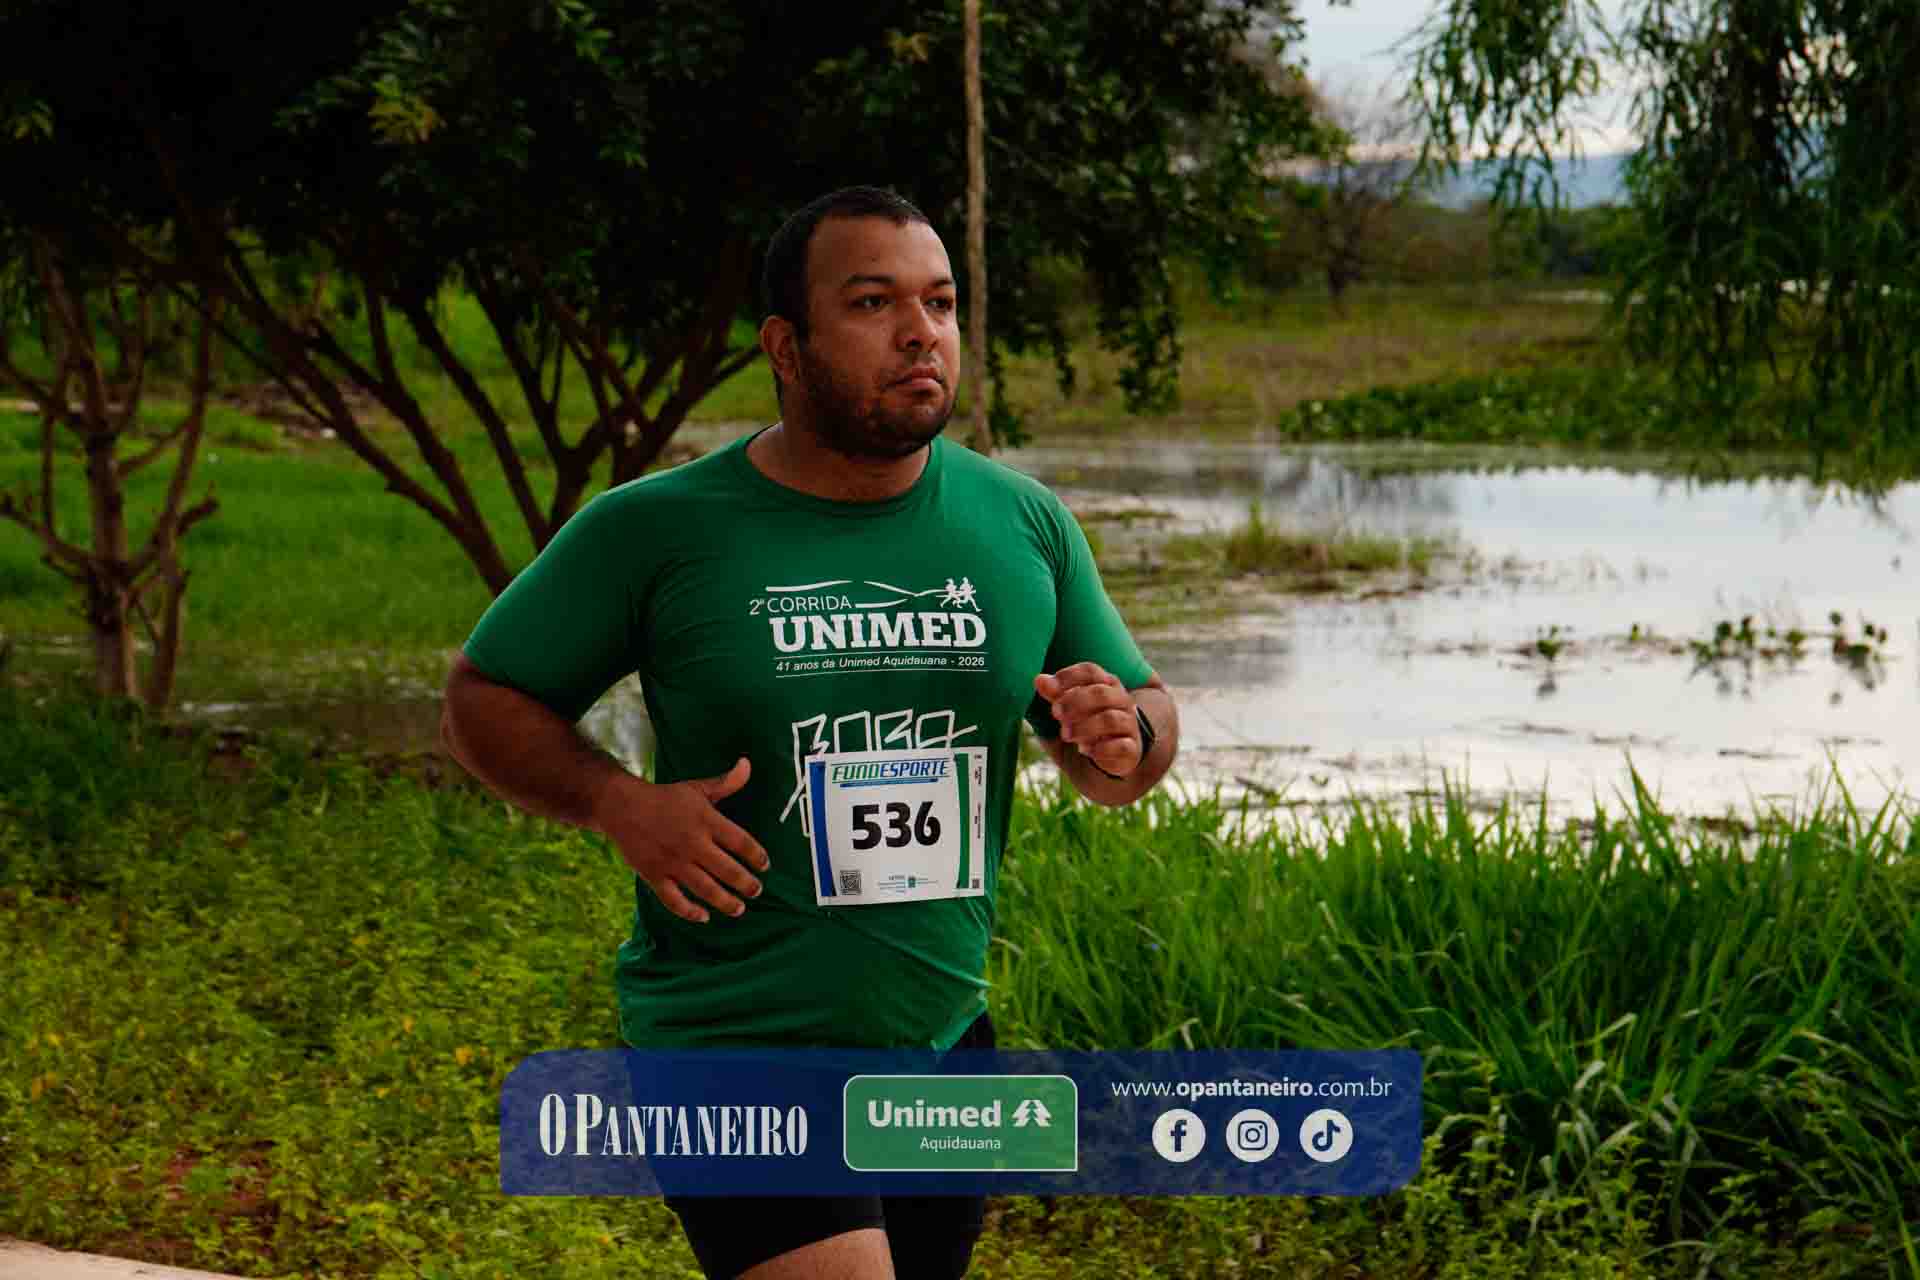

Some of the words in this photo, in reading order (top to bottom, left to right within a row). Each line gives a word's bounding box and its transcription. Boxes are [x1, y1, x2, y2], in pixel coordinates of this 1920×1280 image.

[767, 595, 852, 613] CORRIDA
[769, 612, 986, 653] UNIMED
[776, 661, 790, 671] 41
[793, 661, 819, 671] anos
[822, 658, 835, 669] da
[839, 656, 880, 668] Unimed
[883, 655, 947, 667] Aquidauana
[958, 656, 985, 666] 2026
[832, 759, 949, 781] FUNDESPORTE
[851, 801, 941, 850] 536
